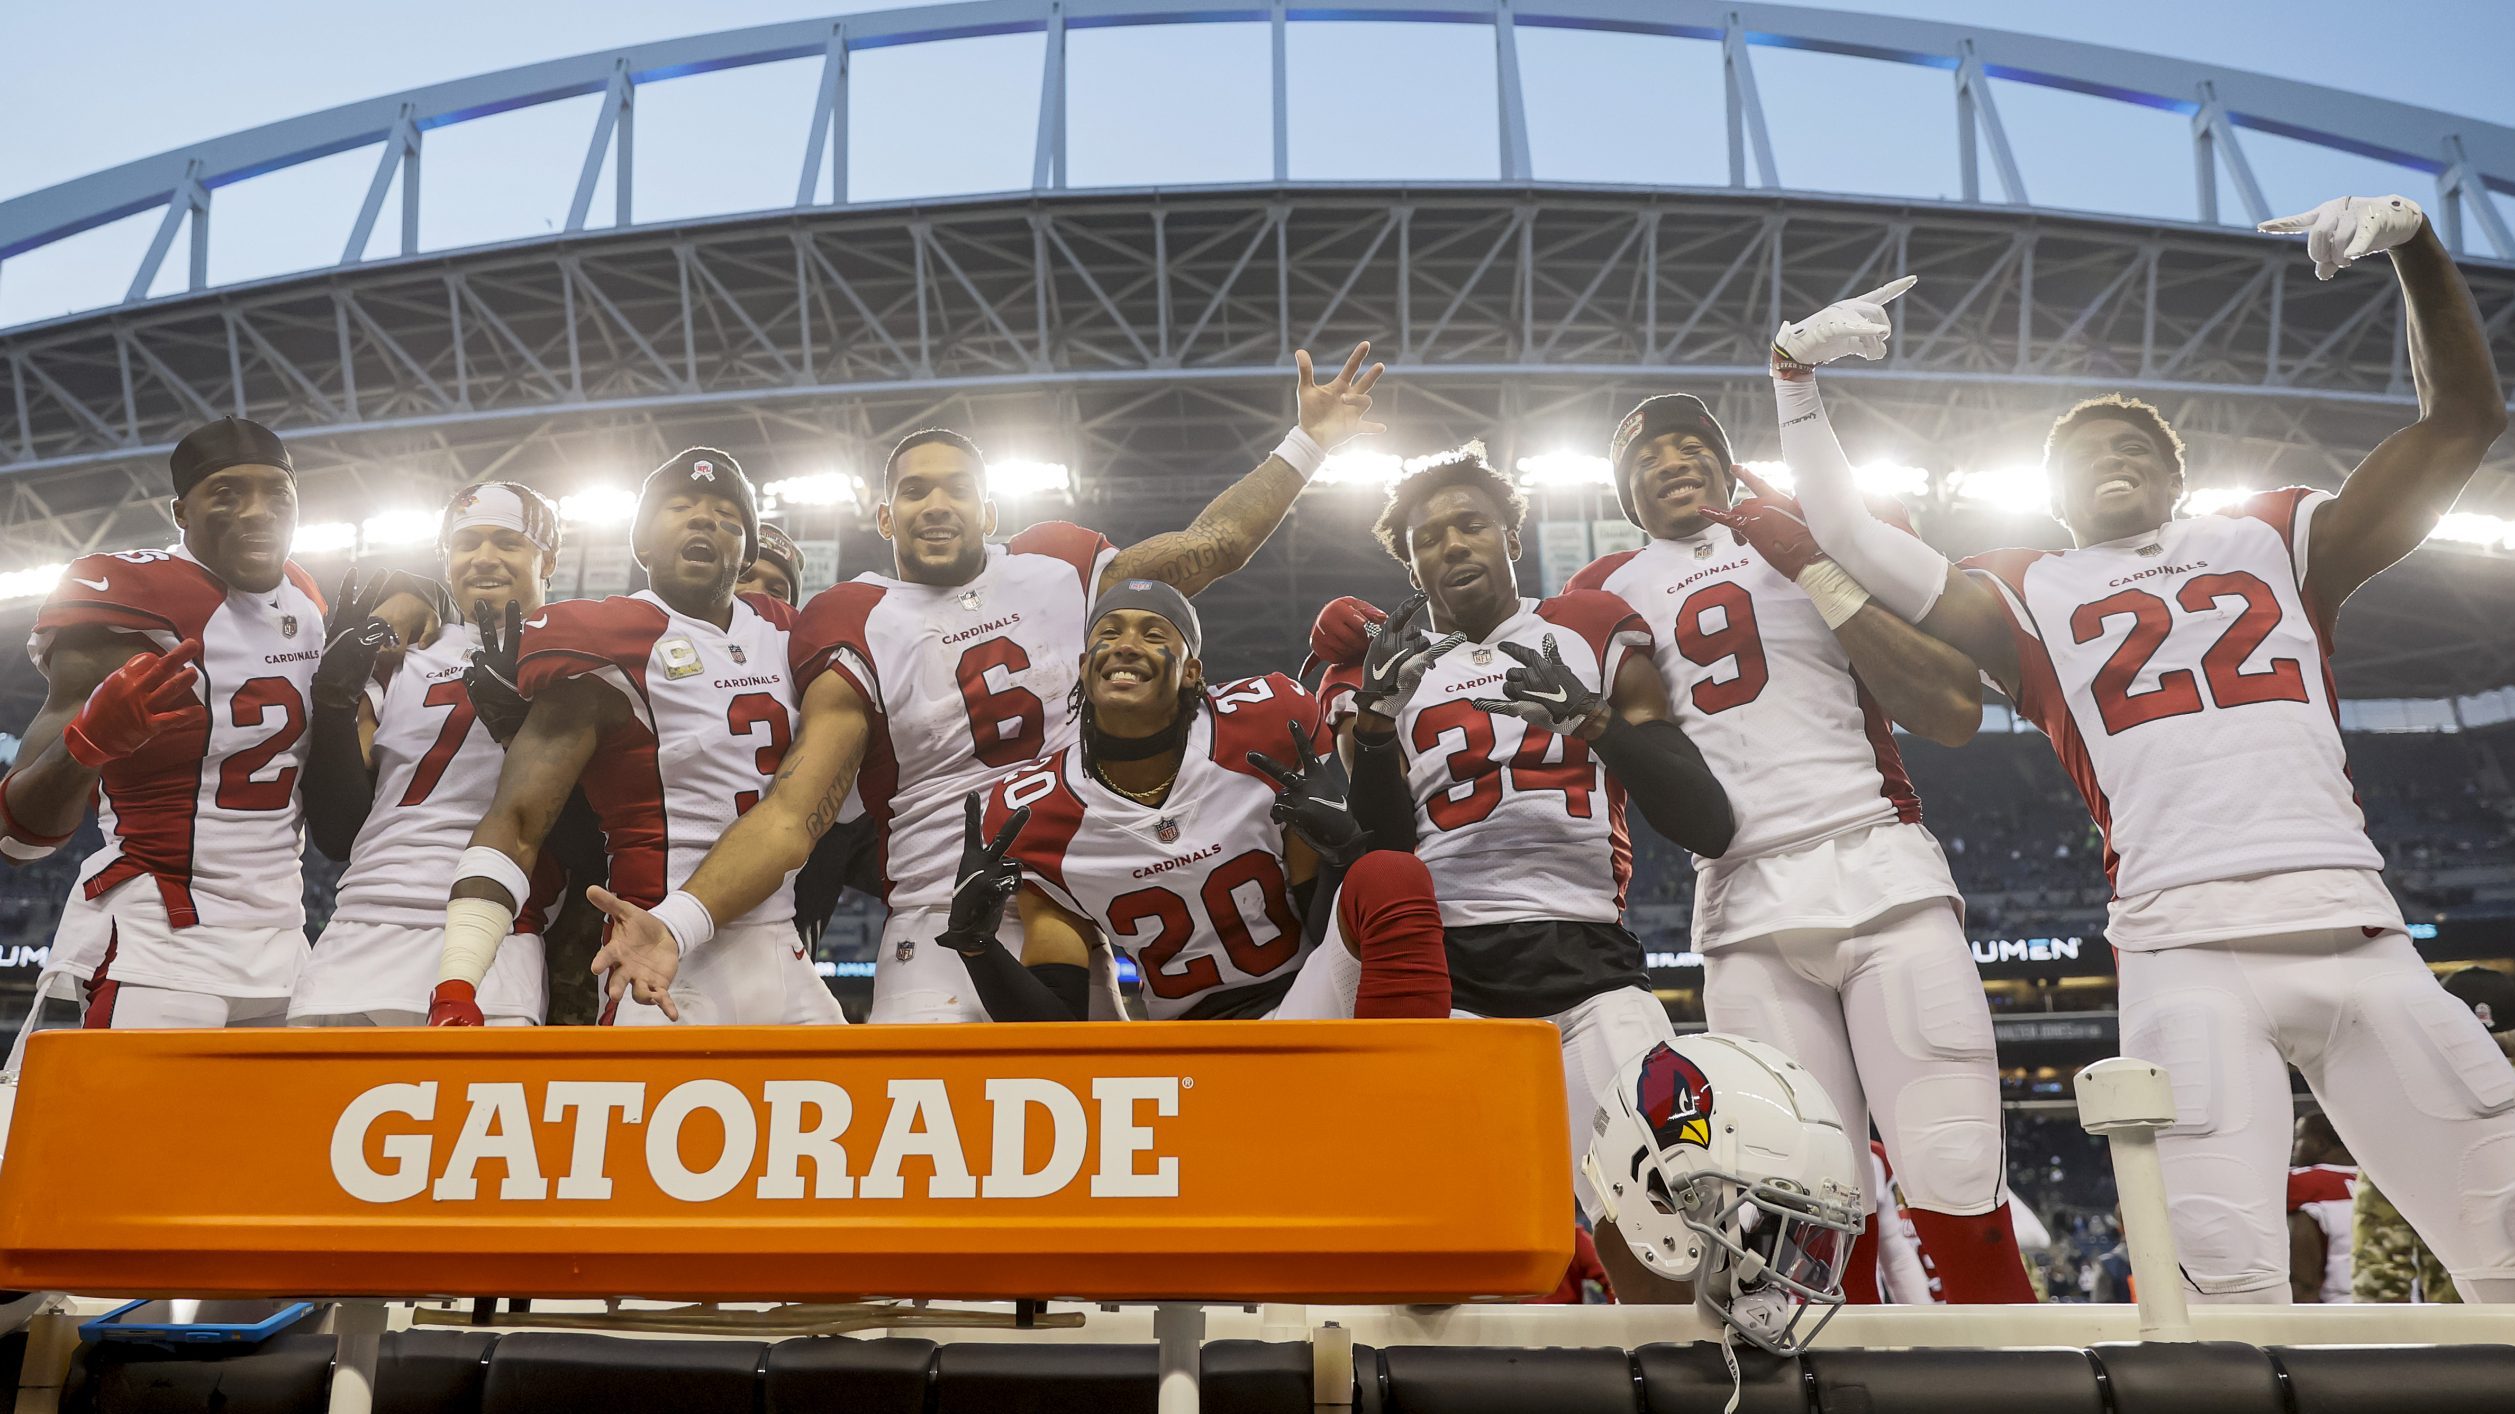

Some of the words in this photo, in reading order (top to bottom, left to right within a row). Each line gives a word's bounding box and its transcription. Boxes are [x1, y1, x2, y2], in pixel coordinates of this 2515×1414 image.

[1666, 558, 1749, 595] CARDINALS
[2109, 560, 2208, 588] CARDINALS
[264, 650, 320, 664] CARDINALS
[942, 613, 1021, 645] CARDINALS
[1674, 580, 1769, 716] 9
[2069, 570, 2310, 737] 22
[426, 667, 462, 679] CARDI
[714, 675, 780, 689] CARDINALS
[955, 635, 1045, 768] 6
[1445, 673, 1504, 693] CARDIN
[215, 675, 307, 811] 2
[395, 678, 477, 807] 7
[727, 692, 792, 817] 3
[1412, 697, 1596, 832] 34
[1132, 843, 1222, 879] CARDINALS
[1106, 849, 1302, 999] 20
[1972, 938, 2079, 963] UMEN
[330, 1076, 1179, 1203] GATORADE
